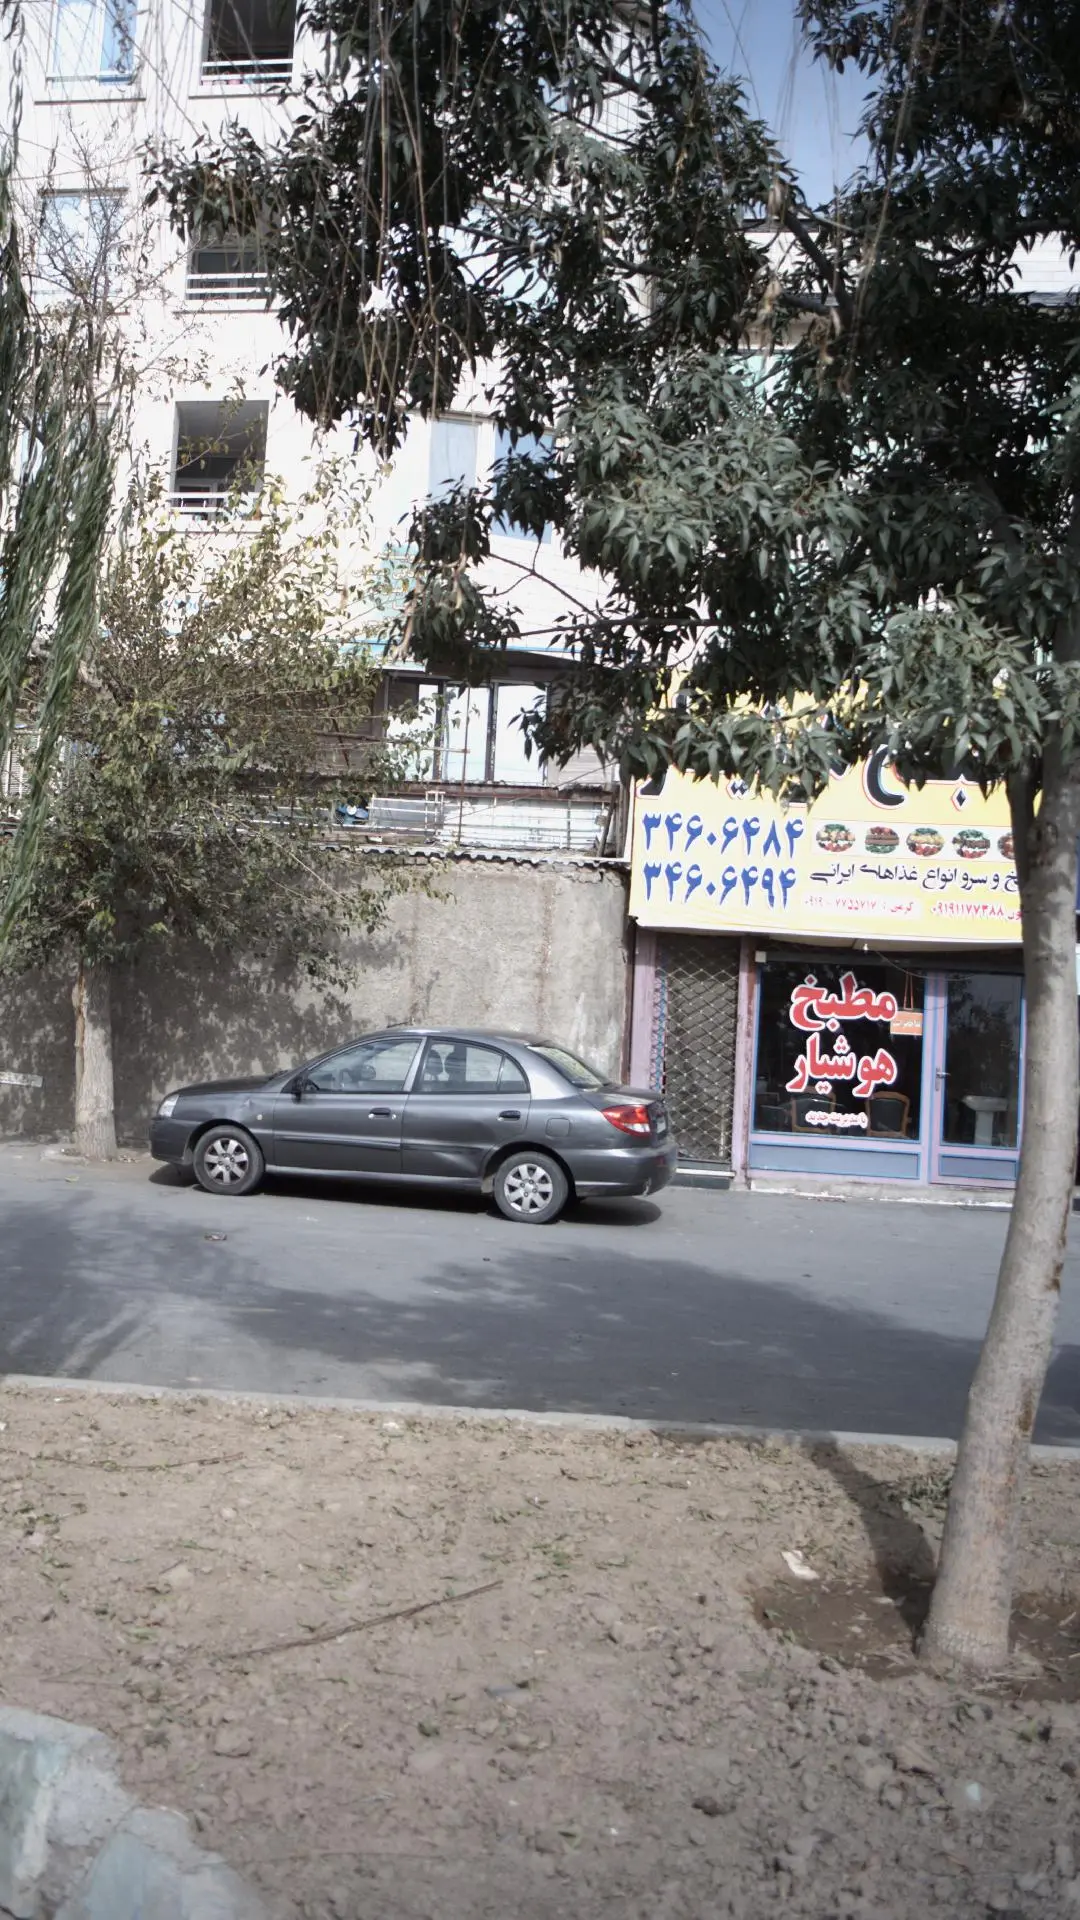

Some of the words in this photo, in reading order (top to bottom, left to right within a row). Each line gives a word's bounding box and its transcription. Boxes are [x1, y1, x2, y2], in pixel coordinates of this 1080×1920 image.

[642, 812, 804, 858] ۳۴۶۰۶۴۸۴
[643, 861, 796, 909] ۳۴۶۰۶۴۹۴
[809, 863, 855, 885] ایرانی
[859, 863, 918, 881] غذاهای
[922, 867, 957, 889] انواع
[789, 971, 898, 1031] مطبخ
[785, 1032, 898, 1097] هوشیار
